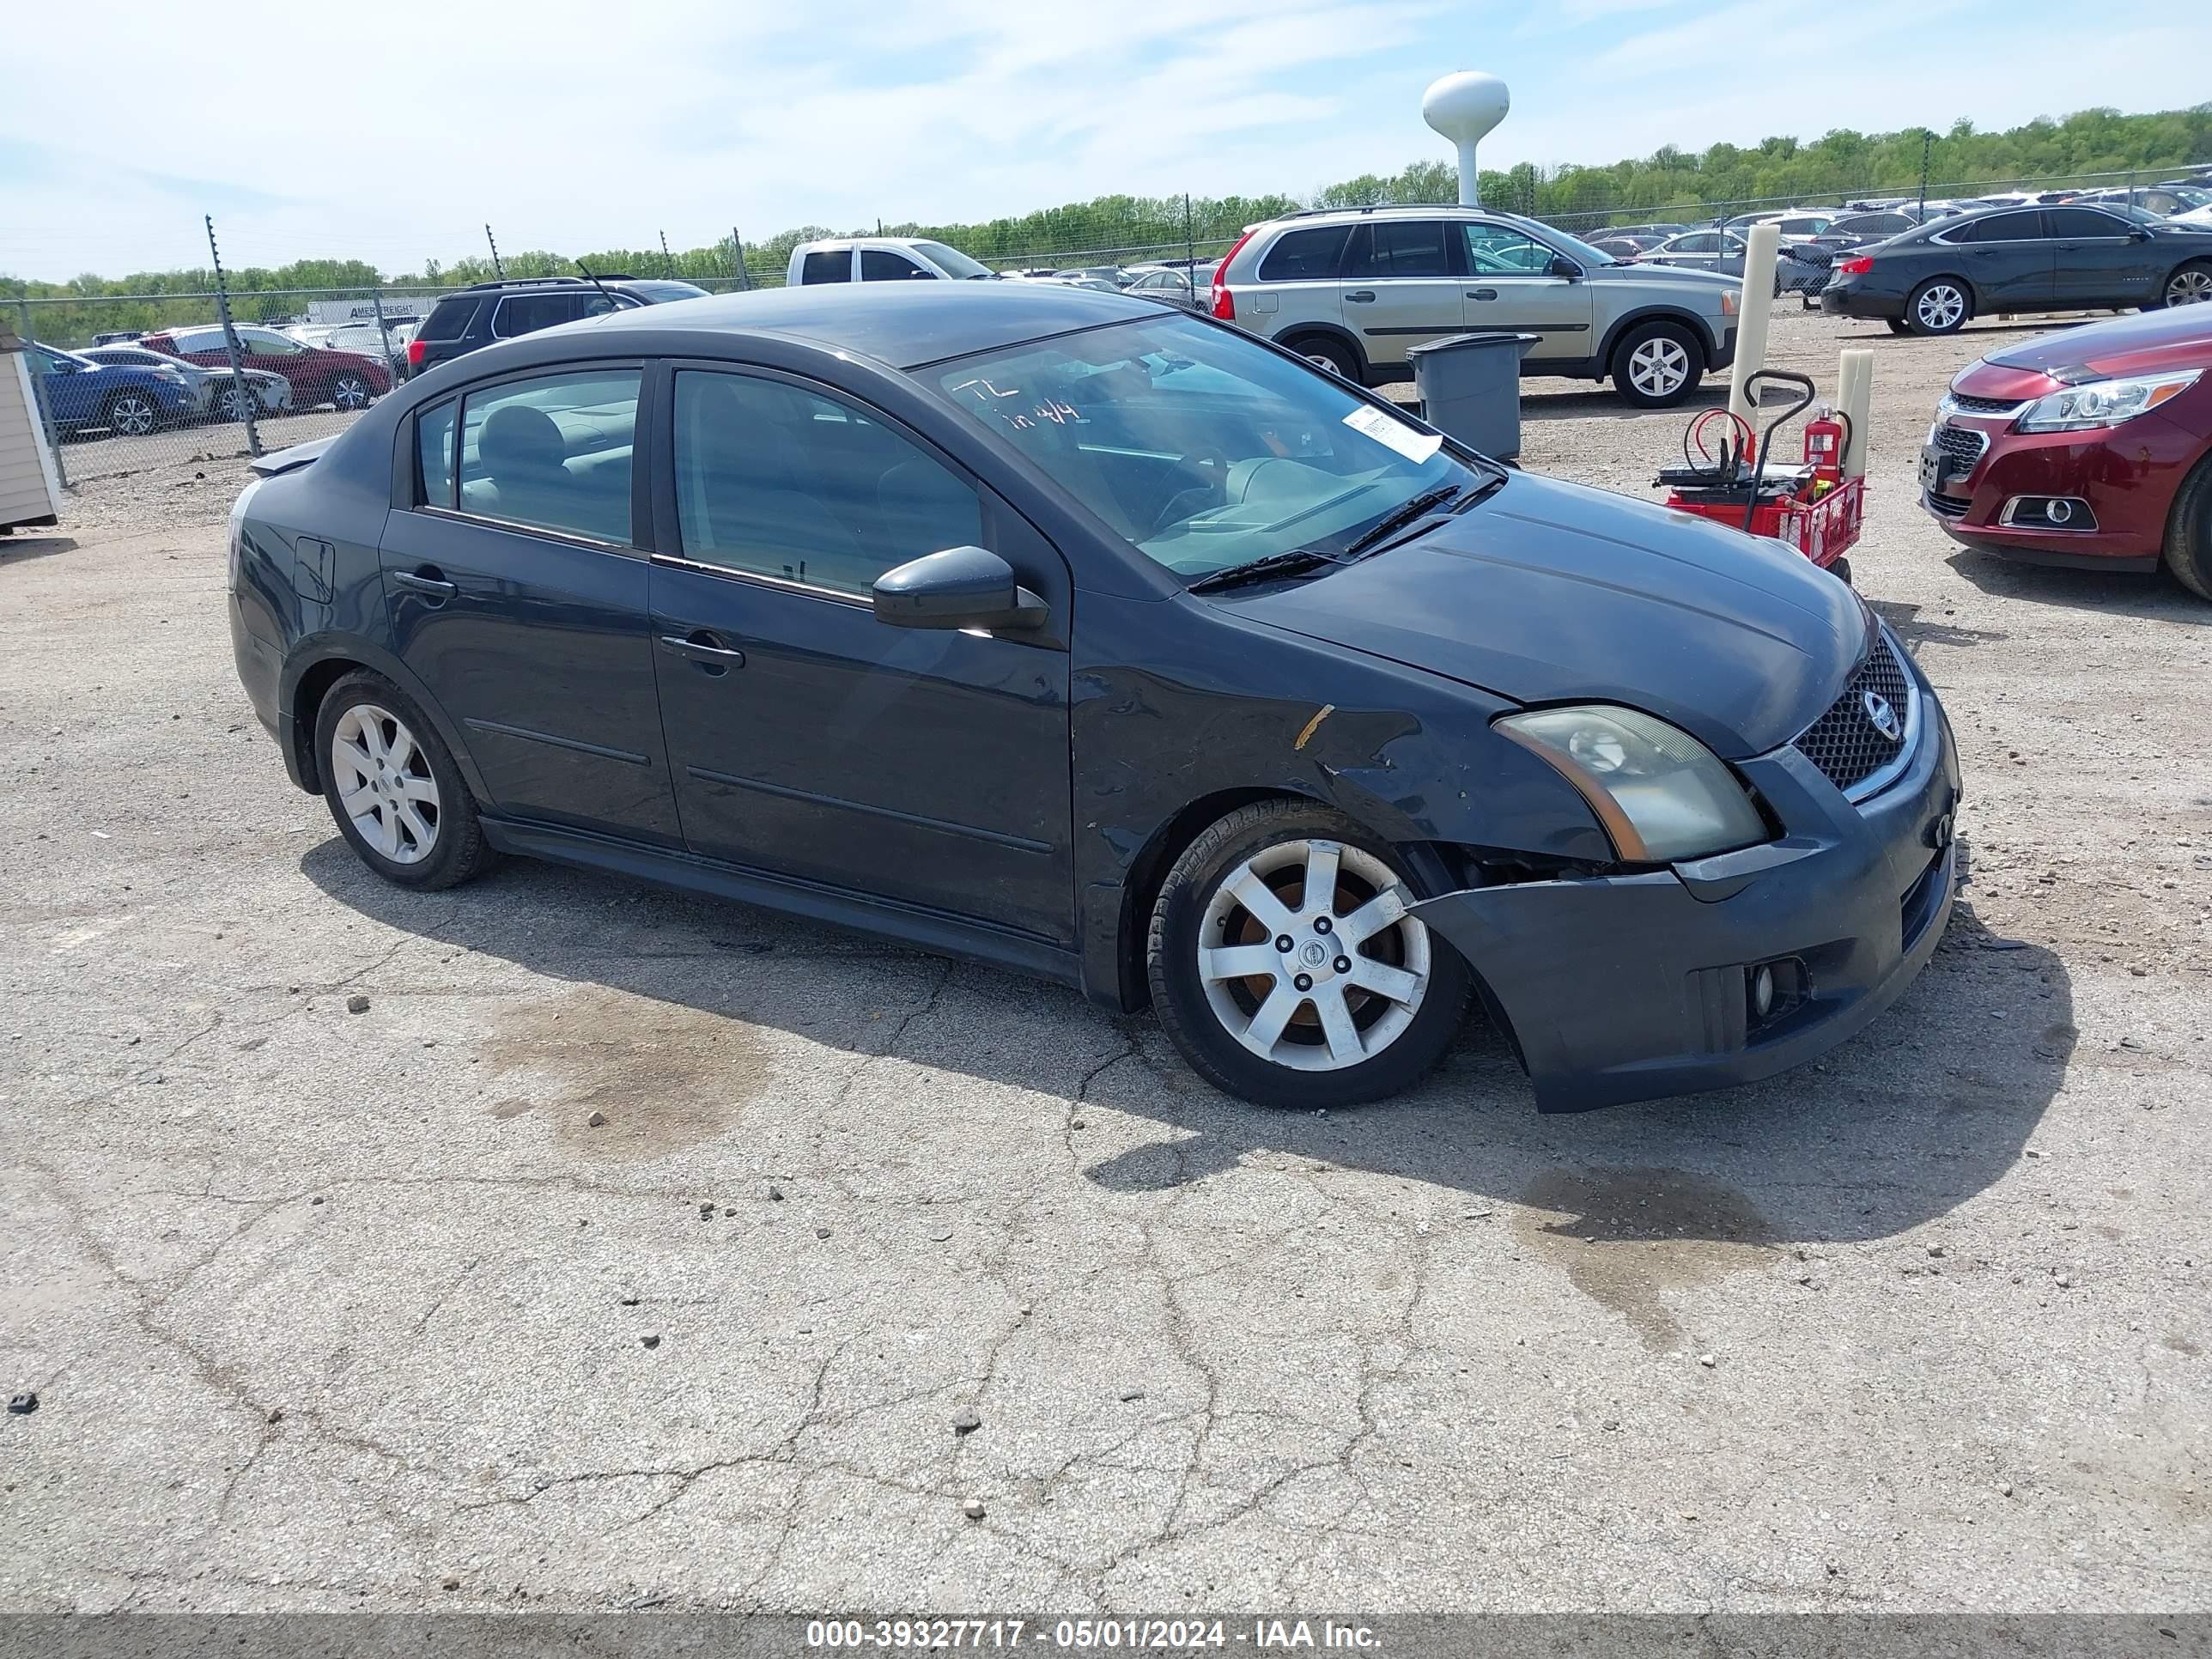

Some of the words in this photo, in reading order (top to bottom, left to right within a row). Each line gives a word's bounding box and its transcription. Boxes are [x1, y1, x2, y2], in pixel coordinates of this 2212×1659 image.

[350, 304, 413, 319] AMERREIGHT
[951, 379, 1019, 401] TL
[993, 407, 1036, 429] in
